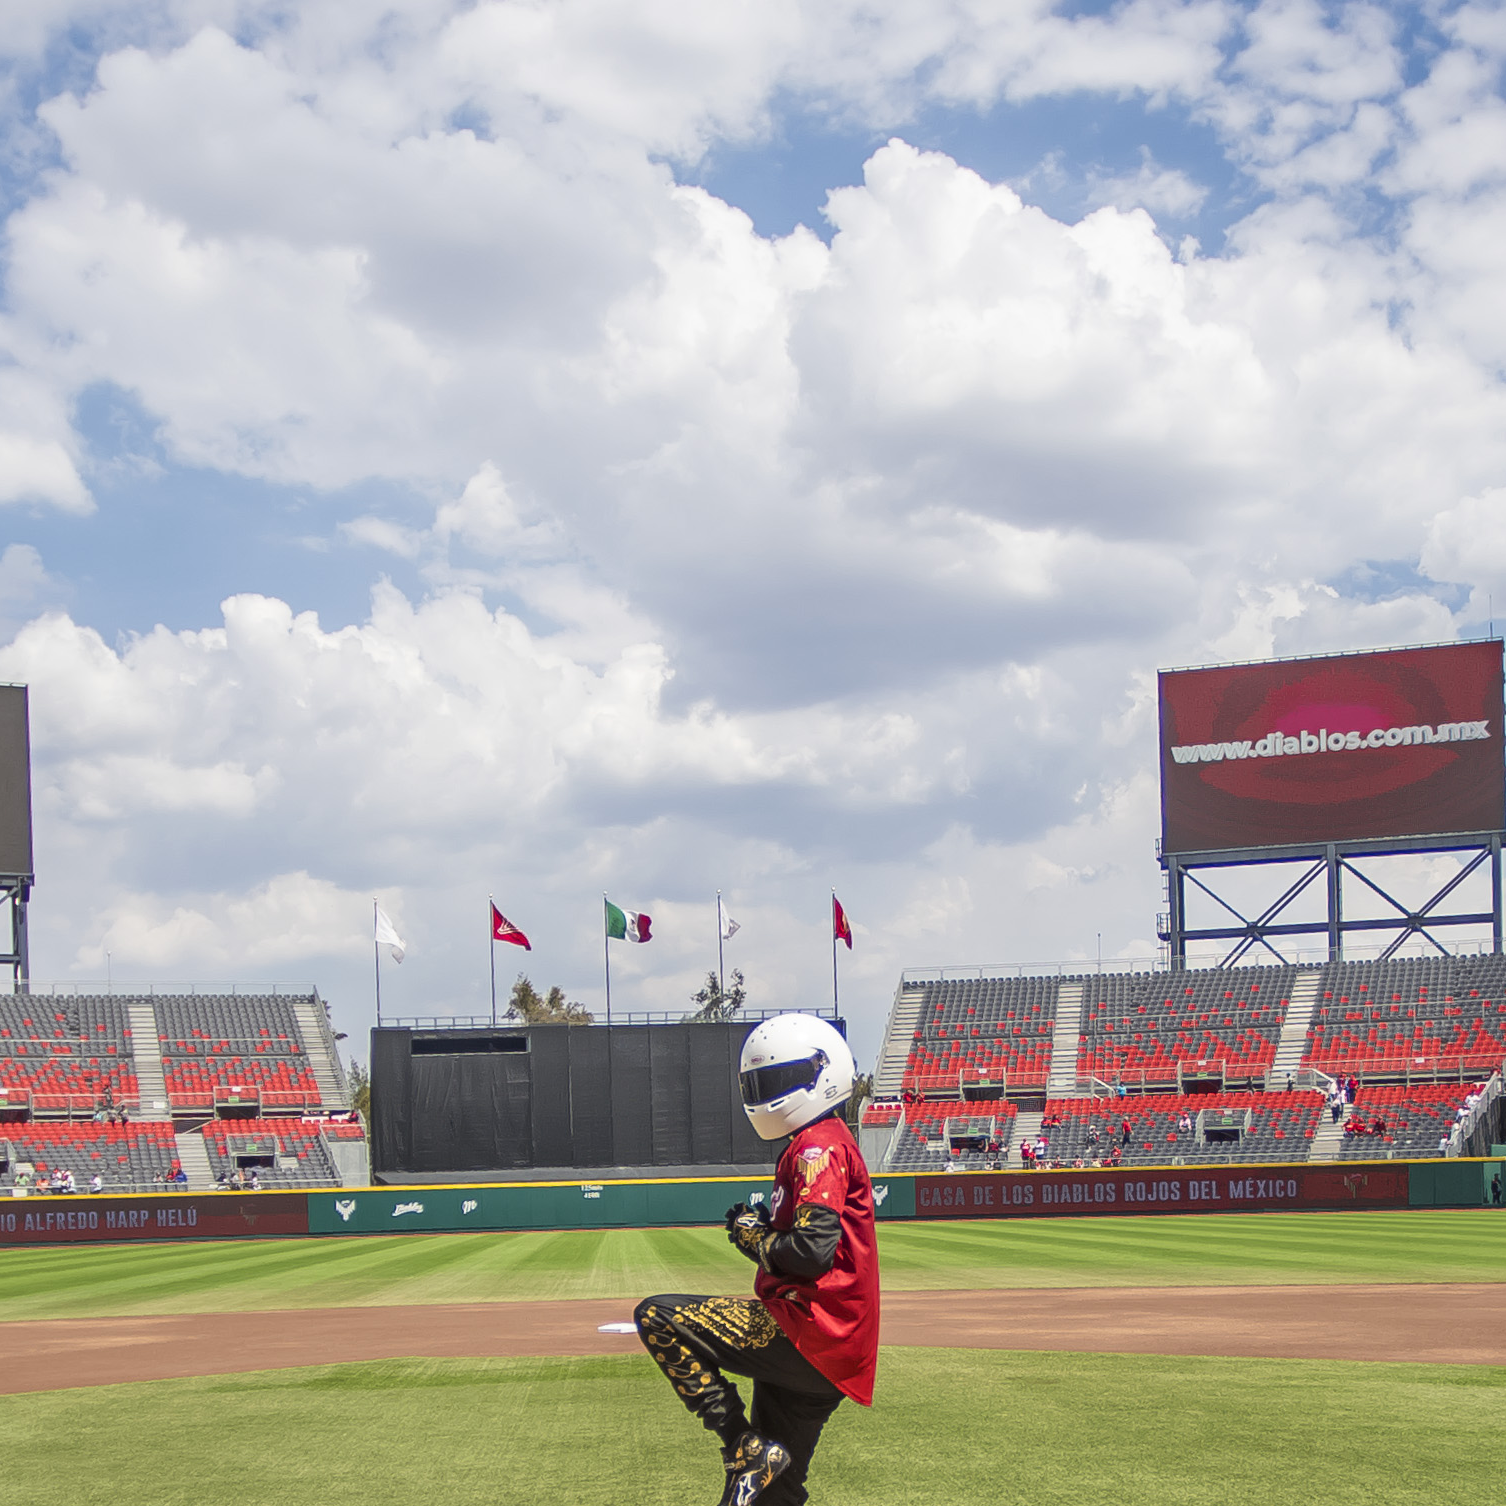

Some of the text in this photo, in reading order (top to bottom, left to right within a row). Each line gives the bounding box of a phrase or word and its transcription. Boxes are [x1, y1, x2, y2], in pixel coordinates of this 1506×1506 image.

[1171, 720, 1490, 764] www.diablos.com.mx
[920, 1177, 1297, 1206] CASA DE LOS DIABLOS ROJOS DEL MÉXICO
[24, 1210, 98, 1231] ALFREDO
[106, 1210, 149, 1228] HARP
[157, 1205, 197, 1227] HELÚ
